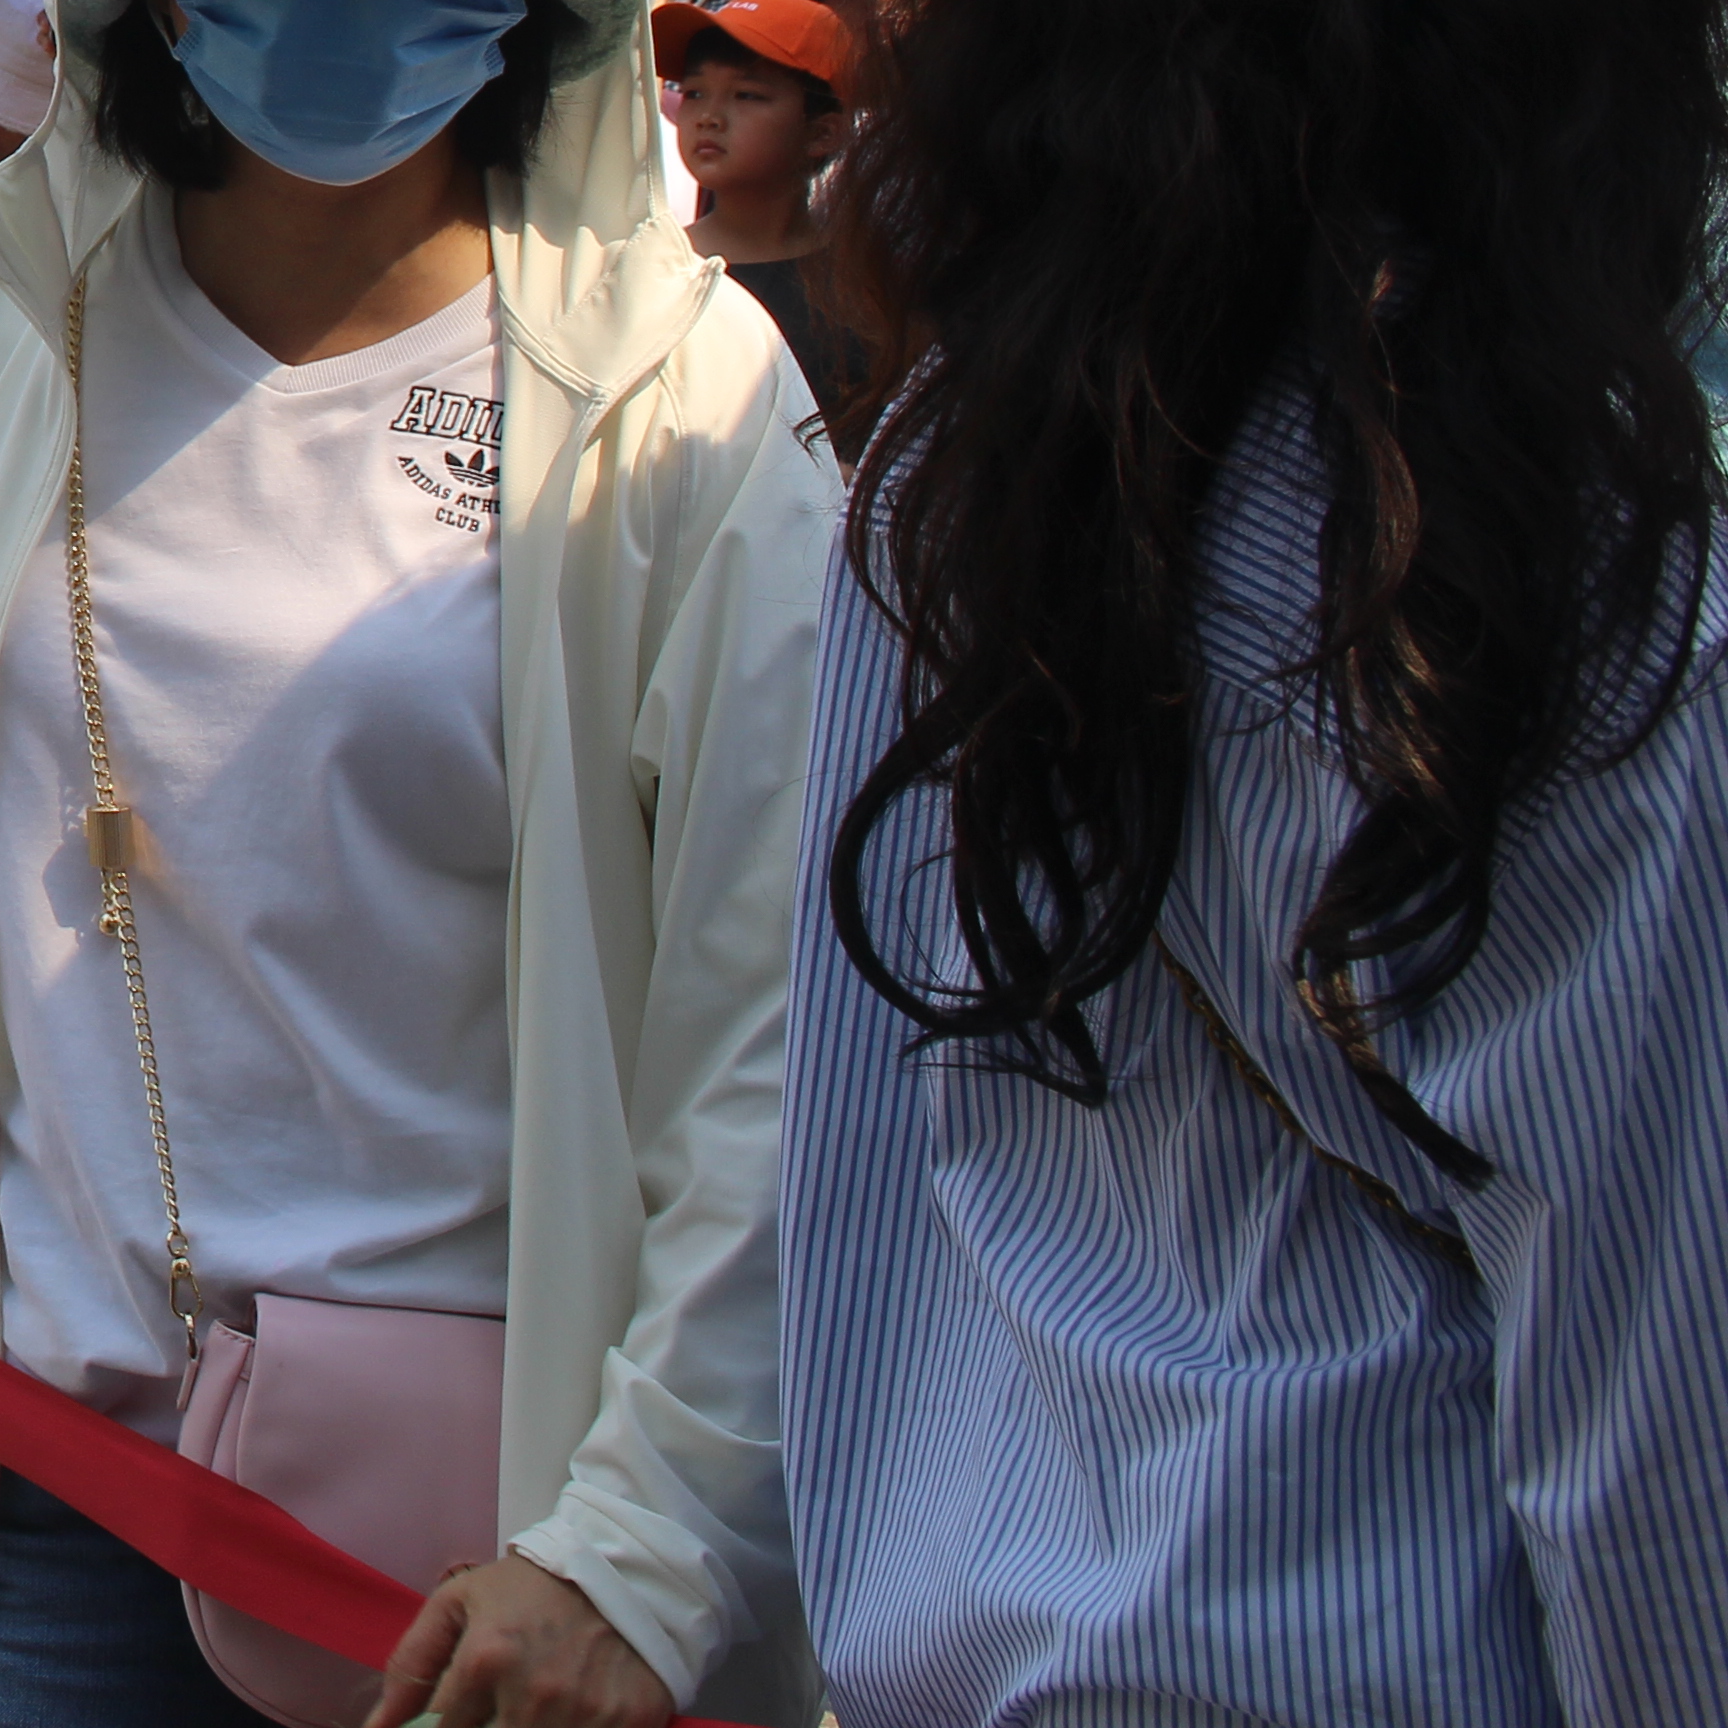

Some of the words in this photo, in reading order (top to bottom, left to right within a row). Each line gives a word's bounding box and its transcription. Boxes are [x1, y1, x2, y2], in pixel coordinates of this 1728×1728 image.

[390, 385, 504, 451] ADID
[397, 455, 453, 501] ADIDAS
[434, 506, 481, 534] CLUB
